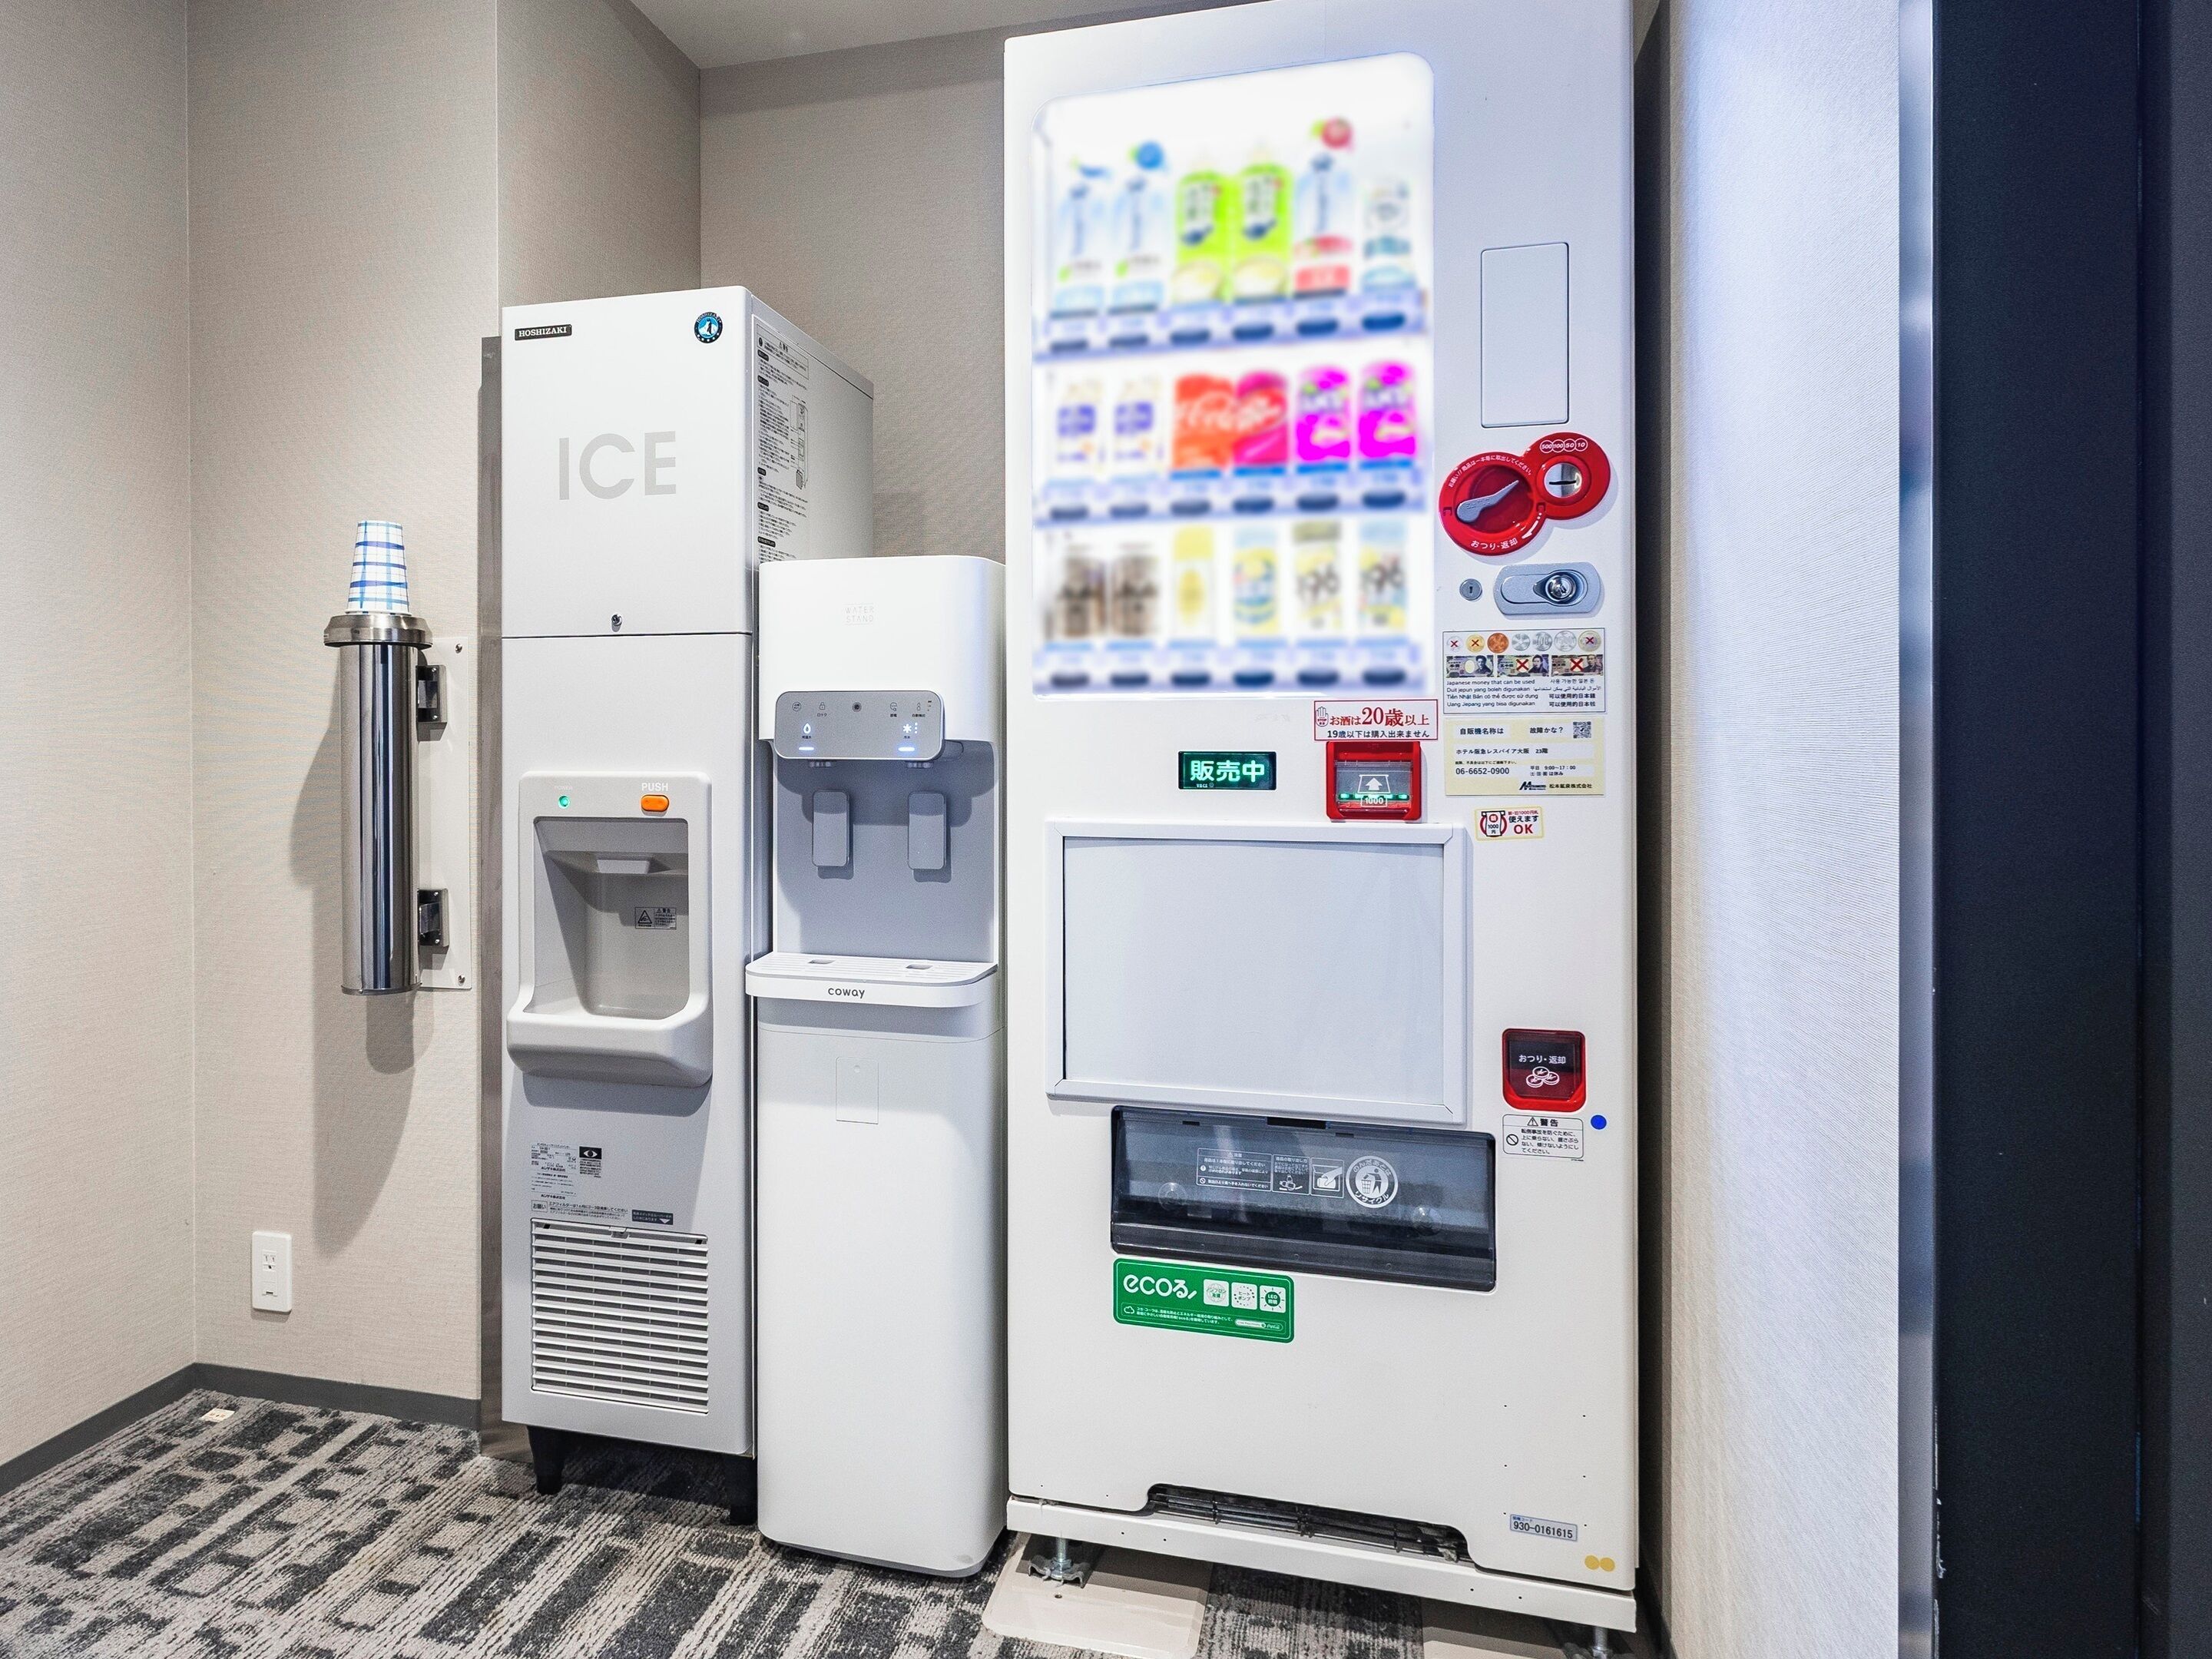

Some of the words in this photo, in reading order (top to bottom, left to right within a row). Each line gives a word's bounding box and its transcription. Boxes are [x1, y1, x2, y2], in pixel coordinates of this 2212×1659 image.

[518, 326, 568, 337] HOSHIZAKI
[559, 431, 676, 500] ICE
[846, 606, 874, 614] WATER
[1330, 707, 1430, 727] お酒は20歳以上
[1327, 730, 1430, 738] 19歳以下は購入出来ません
[1190, 760, 1265, 783] 販売中
[641, 782, 669, 791] PUSH
[1508, 815, 1539, 823] 使えます
[1513, 823, 1533, 834] OK
[828, 988, 865, 999] coway
[1518, 1055, 1566, 1065] おつり・返却
[1540, 1118, 1558, 1127] 警告
[1353, 1160, 1392, 1177] のんだあとは
[1355, 1190, 1389, 1204] リサイクル
[1513, 1521, 1573, 1538] 930-0161615
